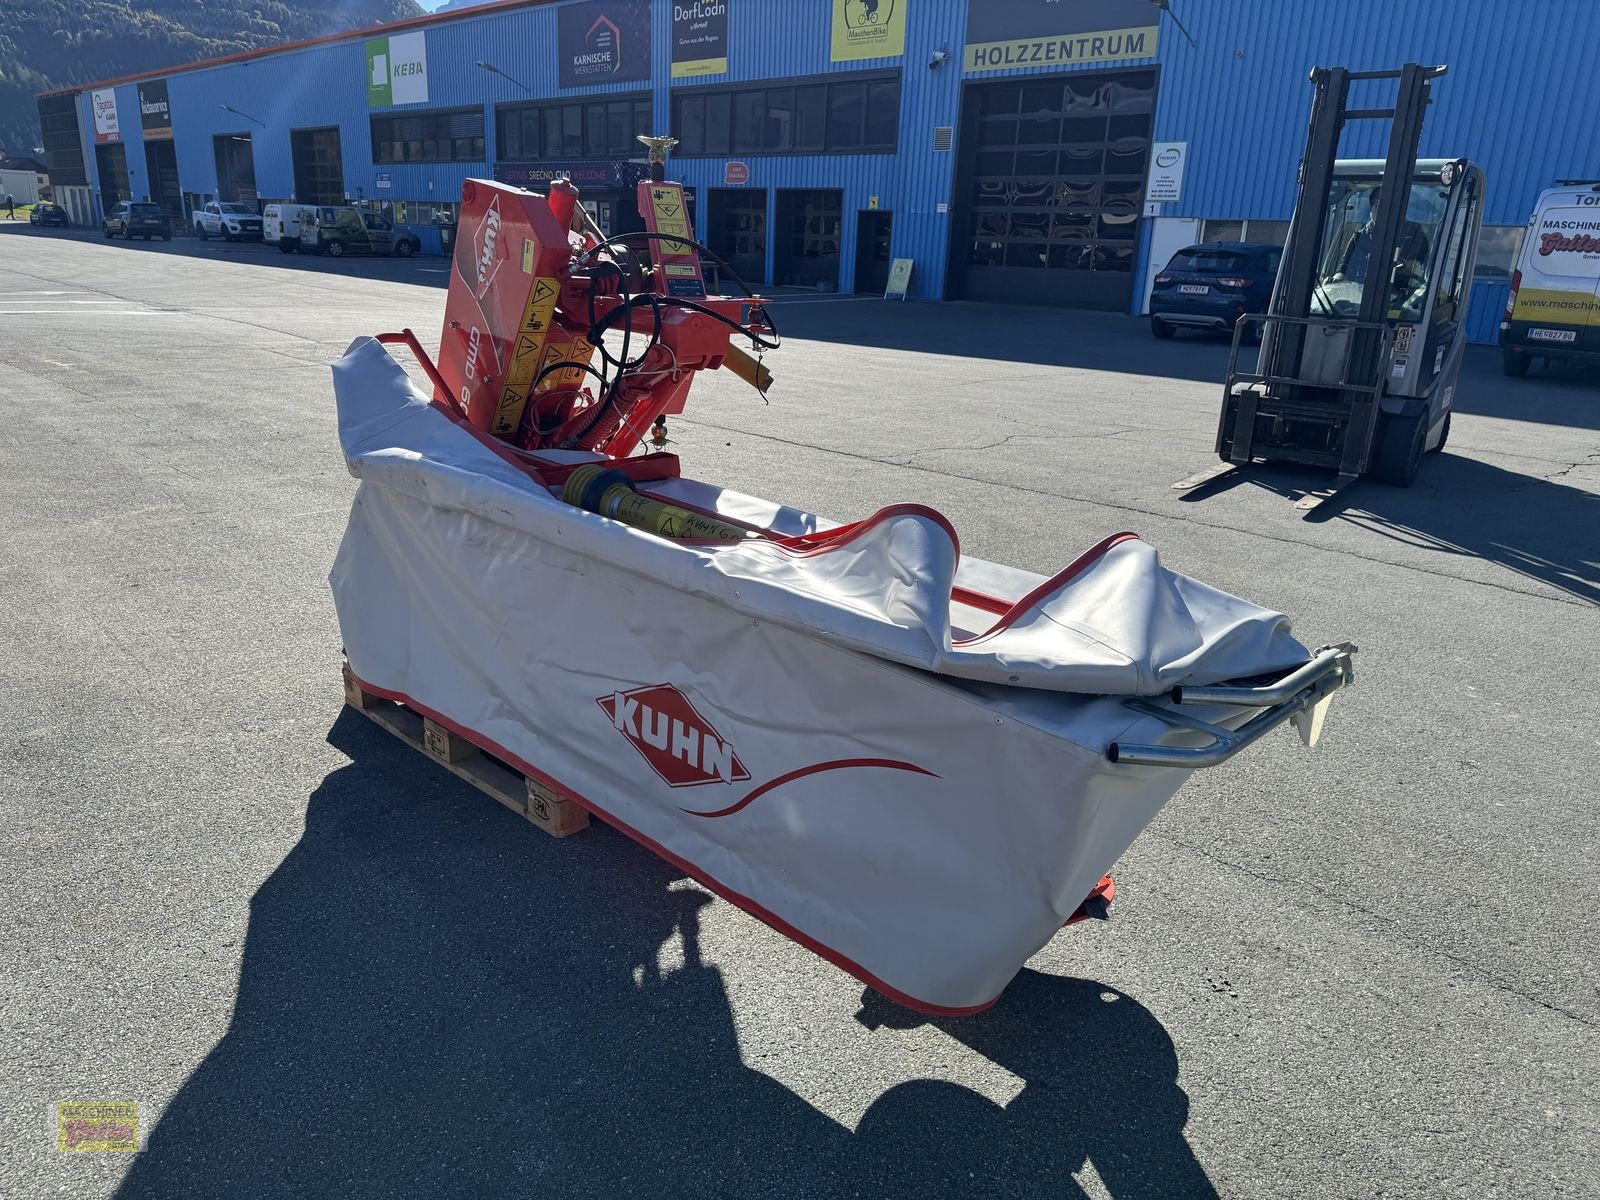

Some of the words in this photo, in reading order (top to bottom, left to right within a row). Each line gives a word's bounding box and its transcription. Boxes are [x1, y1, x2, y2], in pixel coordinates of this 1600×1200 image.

[674, 2, 725, 21] DorfLodn
[848, 26, 887, 38] MauthenBike
[974, 33, 1145, 66] HOLZZENTRUM
[573, 51, 611, 66] KARNISCHE
[393, 62, 423, 77] KEBA
[528, 169, 553, 180] SREČNO
[555, 170, 571, 180] CIAO
[573, 170, 607, 180] WELCOME
[1149, 204, 1155, 214] 1
[1520, 299, 1600, 311] www.maschin
[465, 326, 480, 380] GMD
[614, 690, 733, 785] KUHN
[534, 797, 549, 818] EPAL
